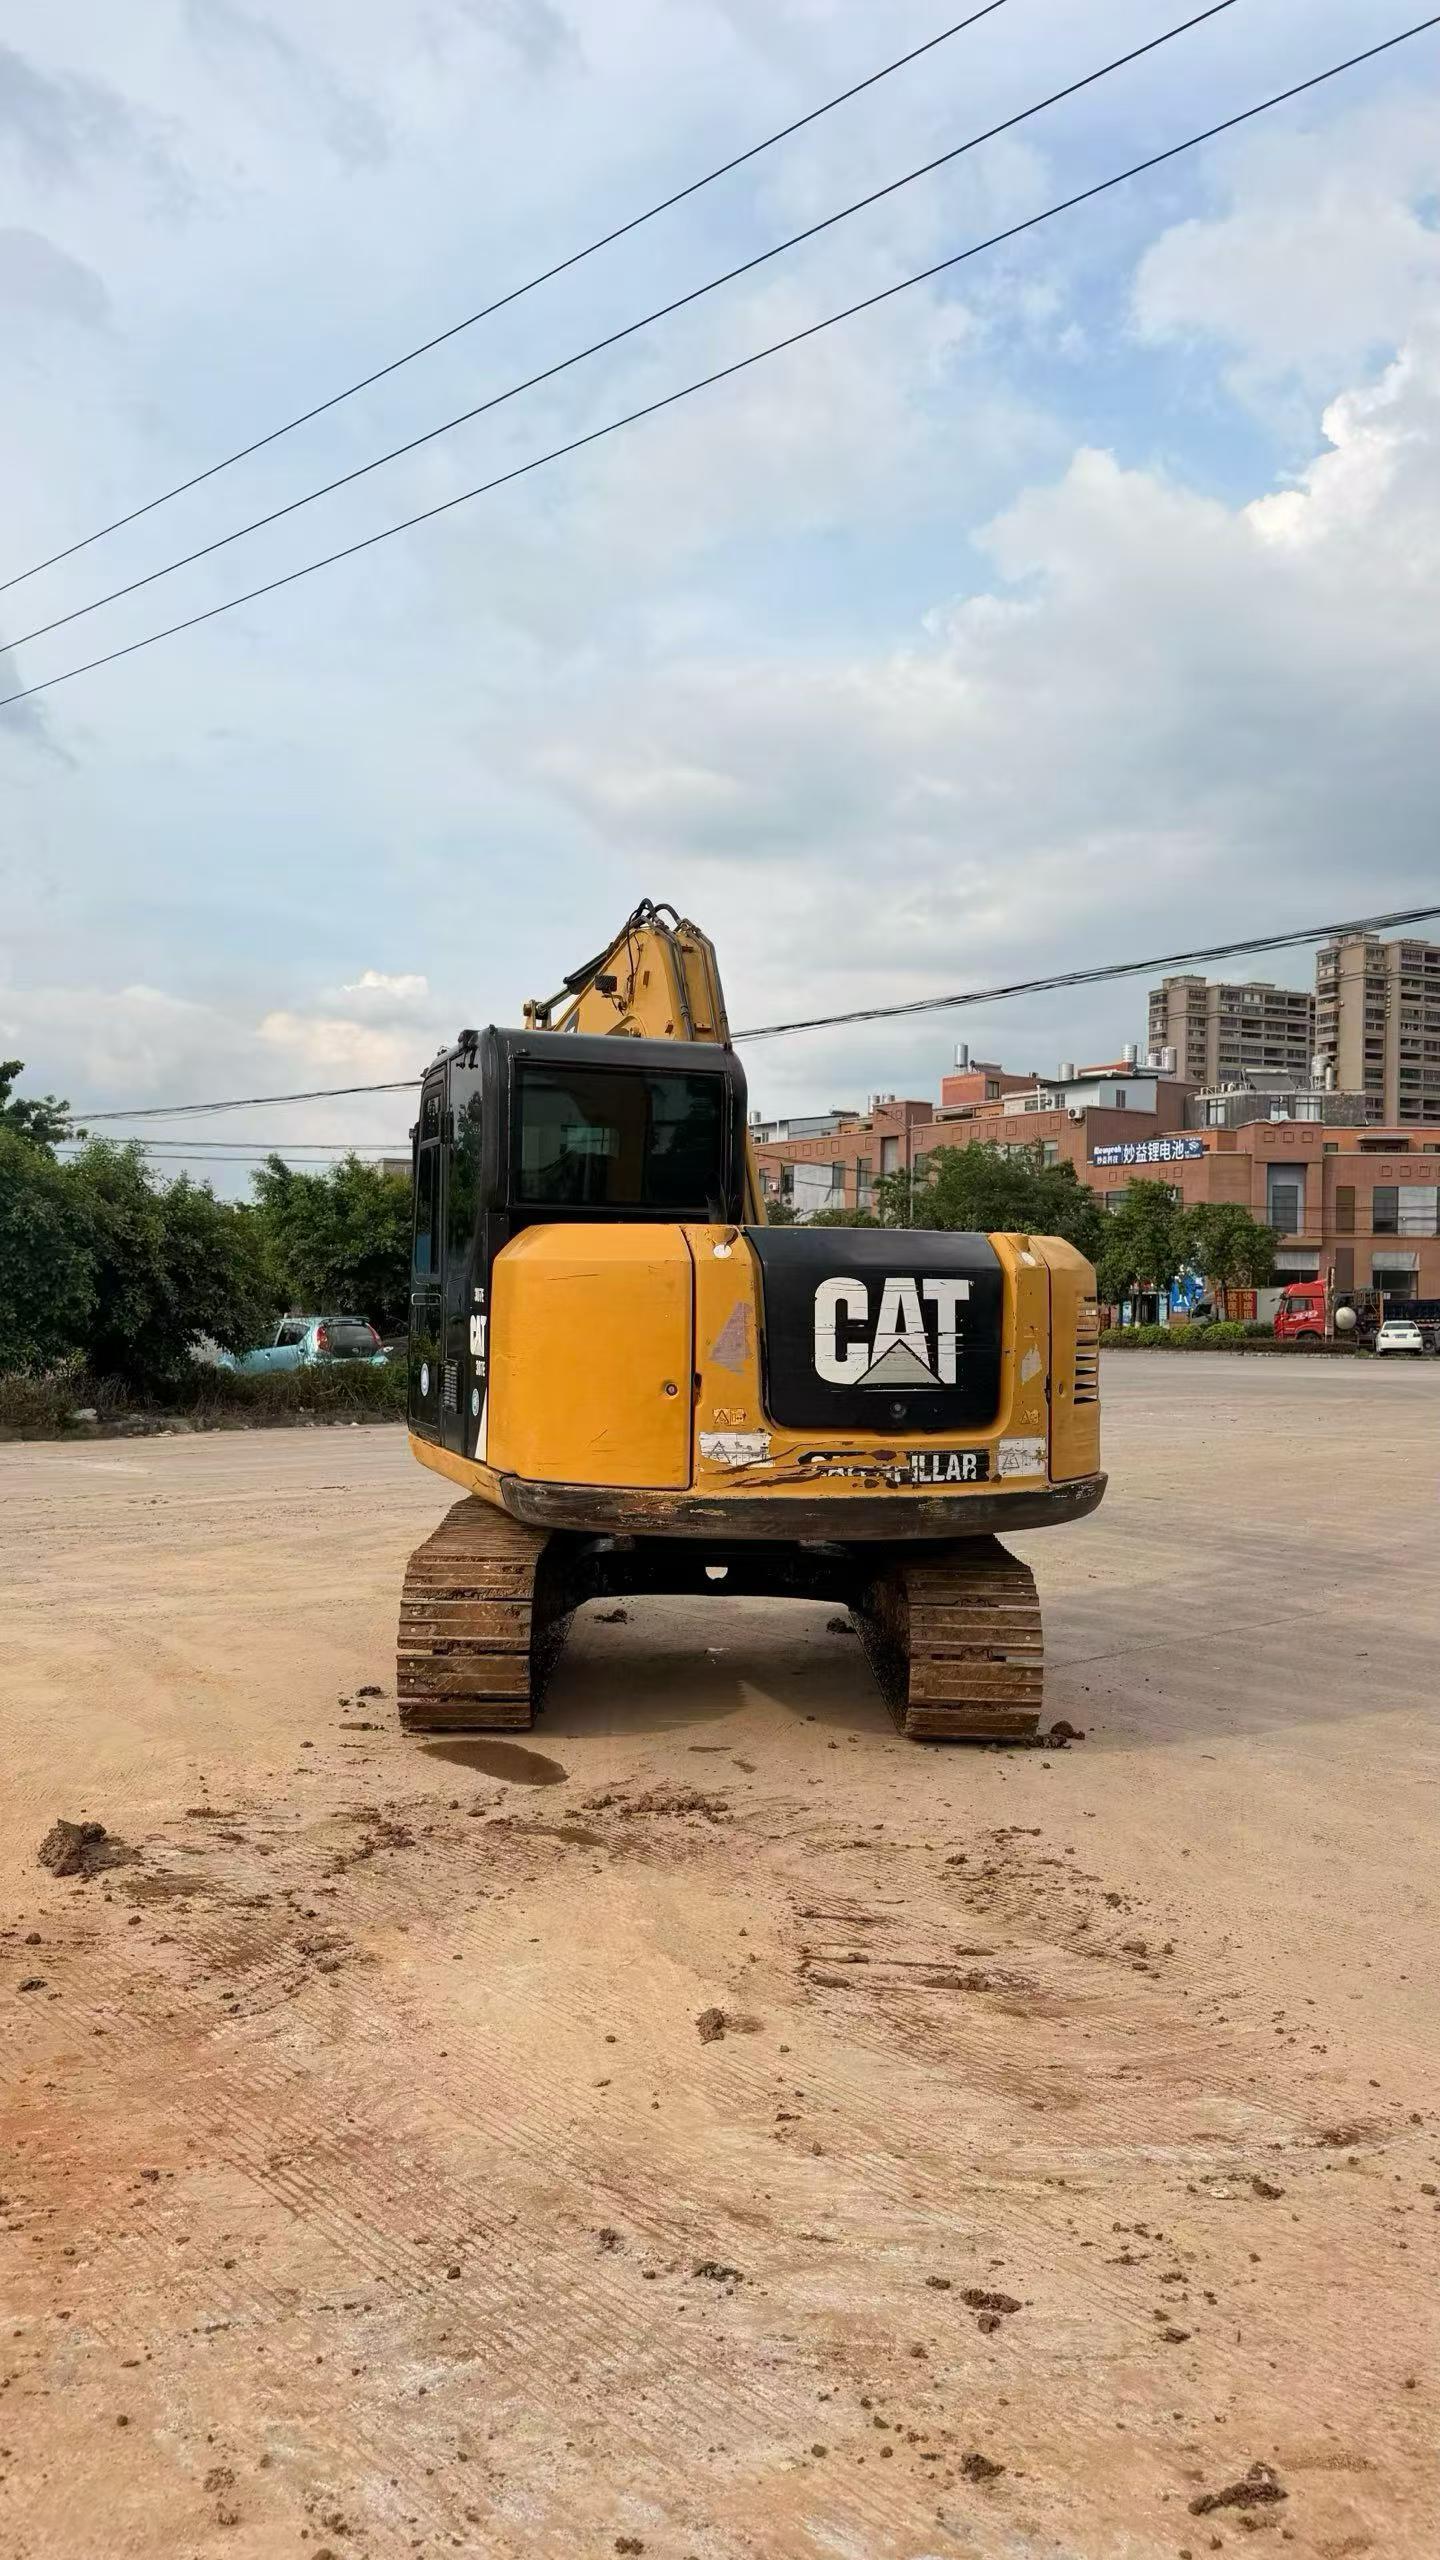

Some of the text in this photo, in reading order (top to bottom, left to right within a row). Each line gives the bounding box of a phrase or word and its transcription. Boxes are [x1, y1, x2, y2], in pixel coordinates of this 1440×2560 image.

[1123, 1140, 1184, 1163] 妙益锂电池
[470, 1315, 487, 1357] CAT
[815, 1277, 969, 1384] CAT
